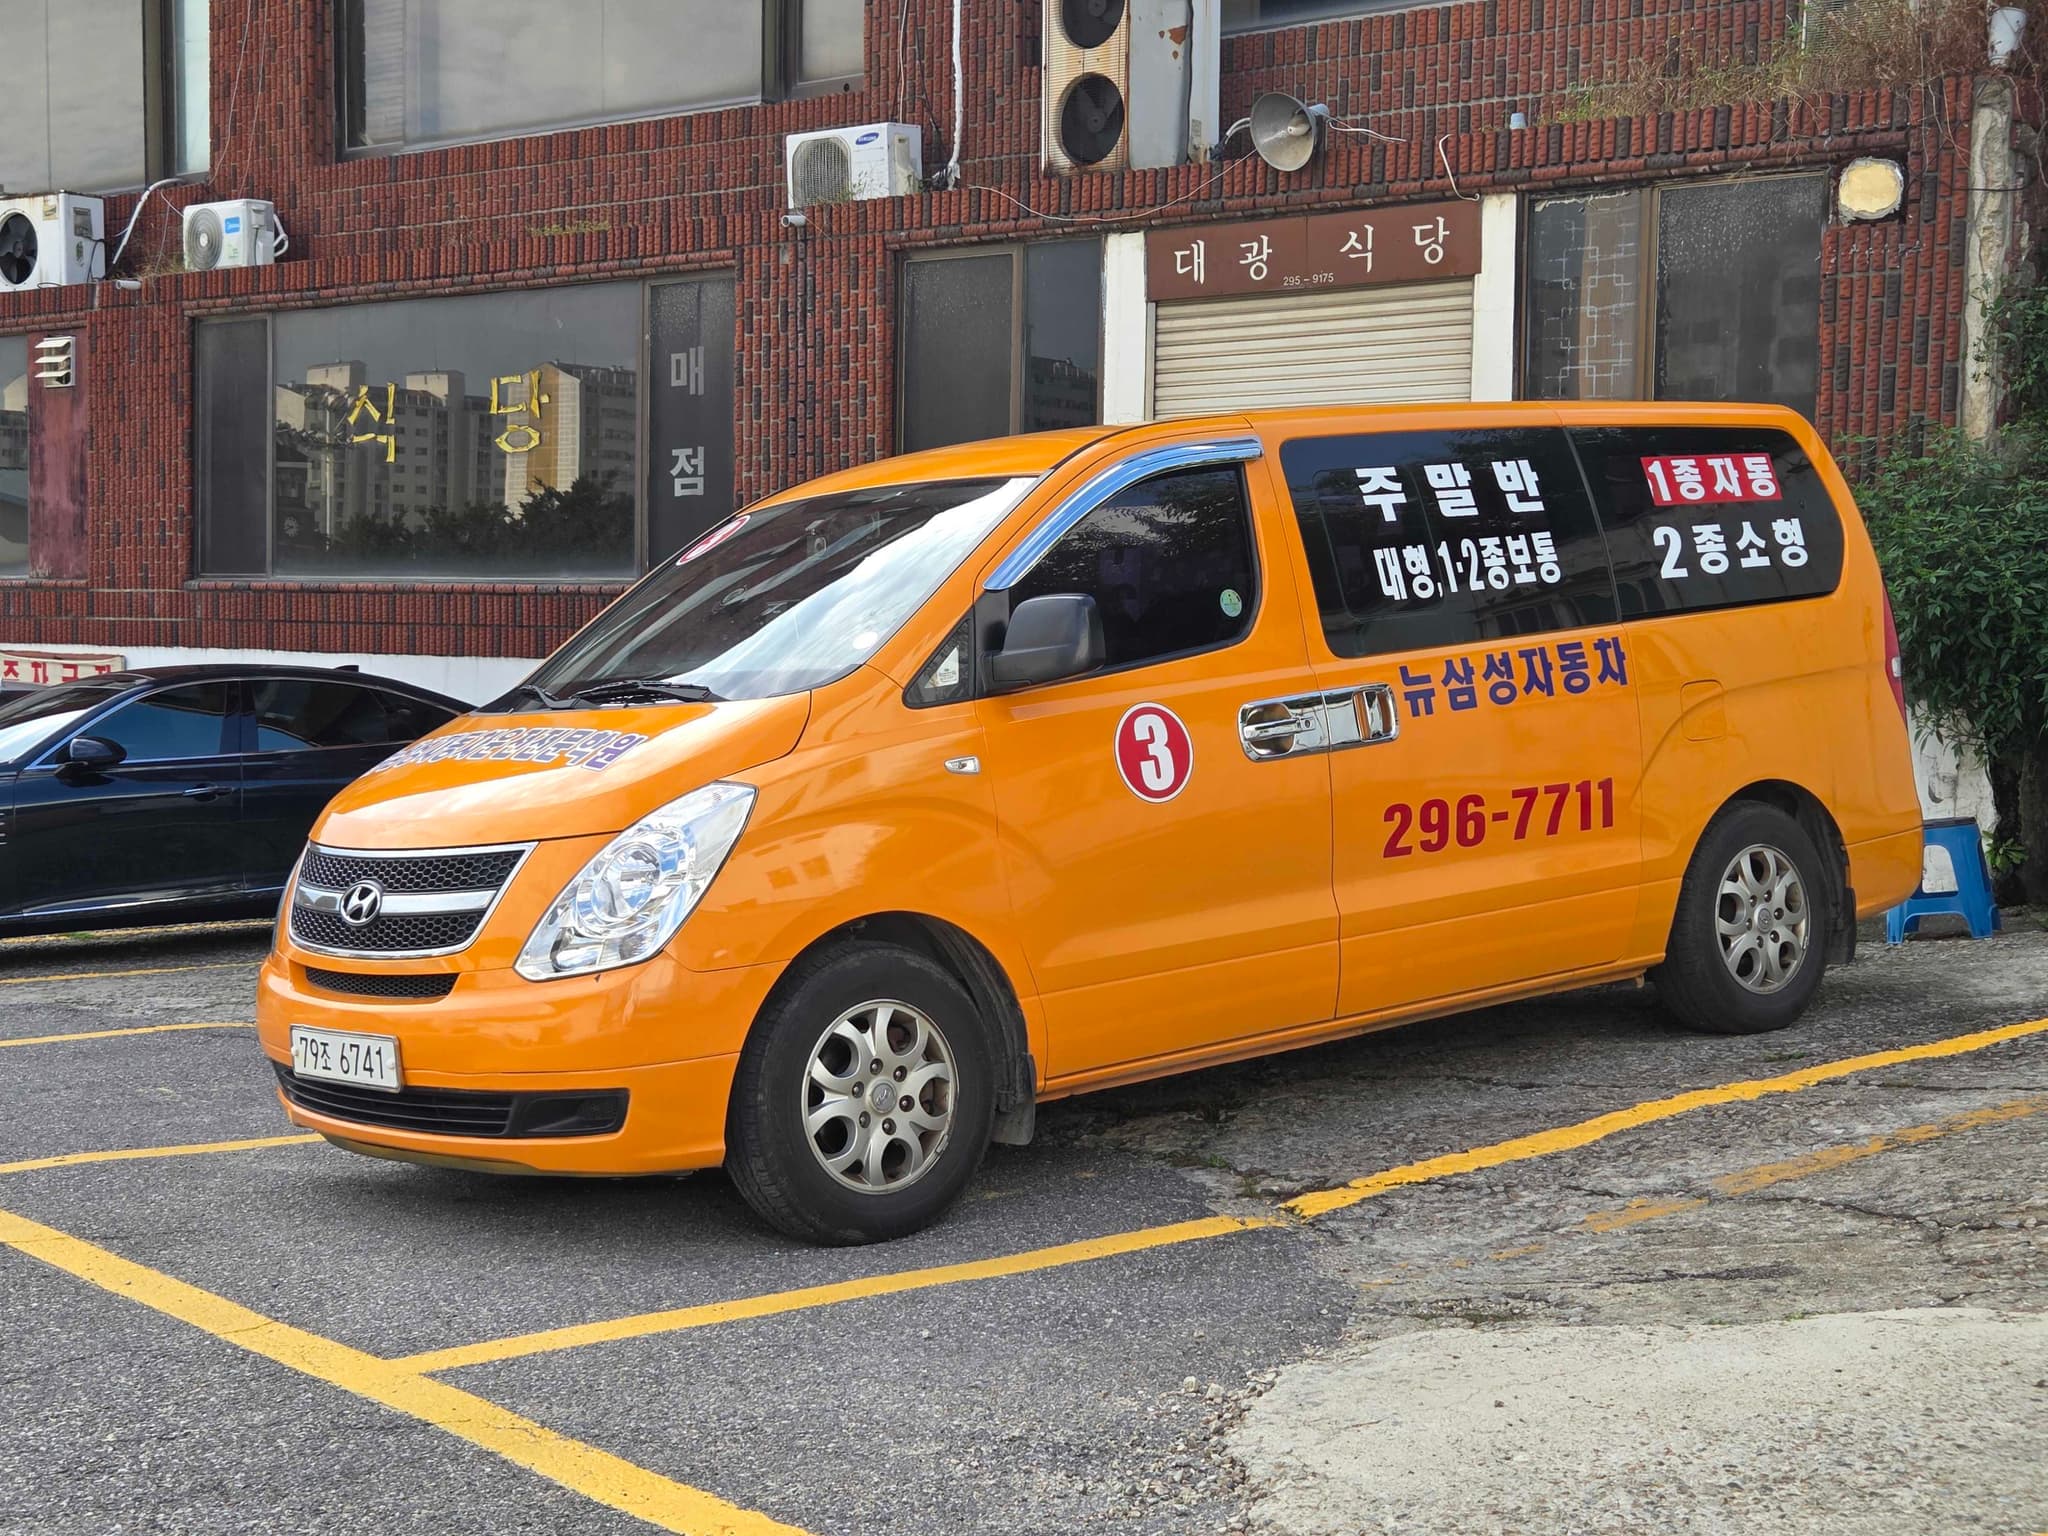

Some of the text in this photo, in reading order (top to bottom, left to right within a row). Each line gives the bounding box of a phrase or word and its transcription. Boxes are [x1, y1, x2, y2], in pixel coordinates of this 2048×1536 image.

[346, 369, 551, 464] 식당
[669, 345, 705, 497] 매점
[1355, 459, 1545, 522] 주말반
[1648, 457, 1776, 501] 1종자동
[1653, 518, 1808, 579] 2종소형
[1399, 636, 1627, 717] 뉴삼성자동차
[1134, 714, 1175, 791] 3
[1383, 777, 1613, 858] 296-7711
[300, 1037, 384, 1080] 79조 6741
